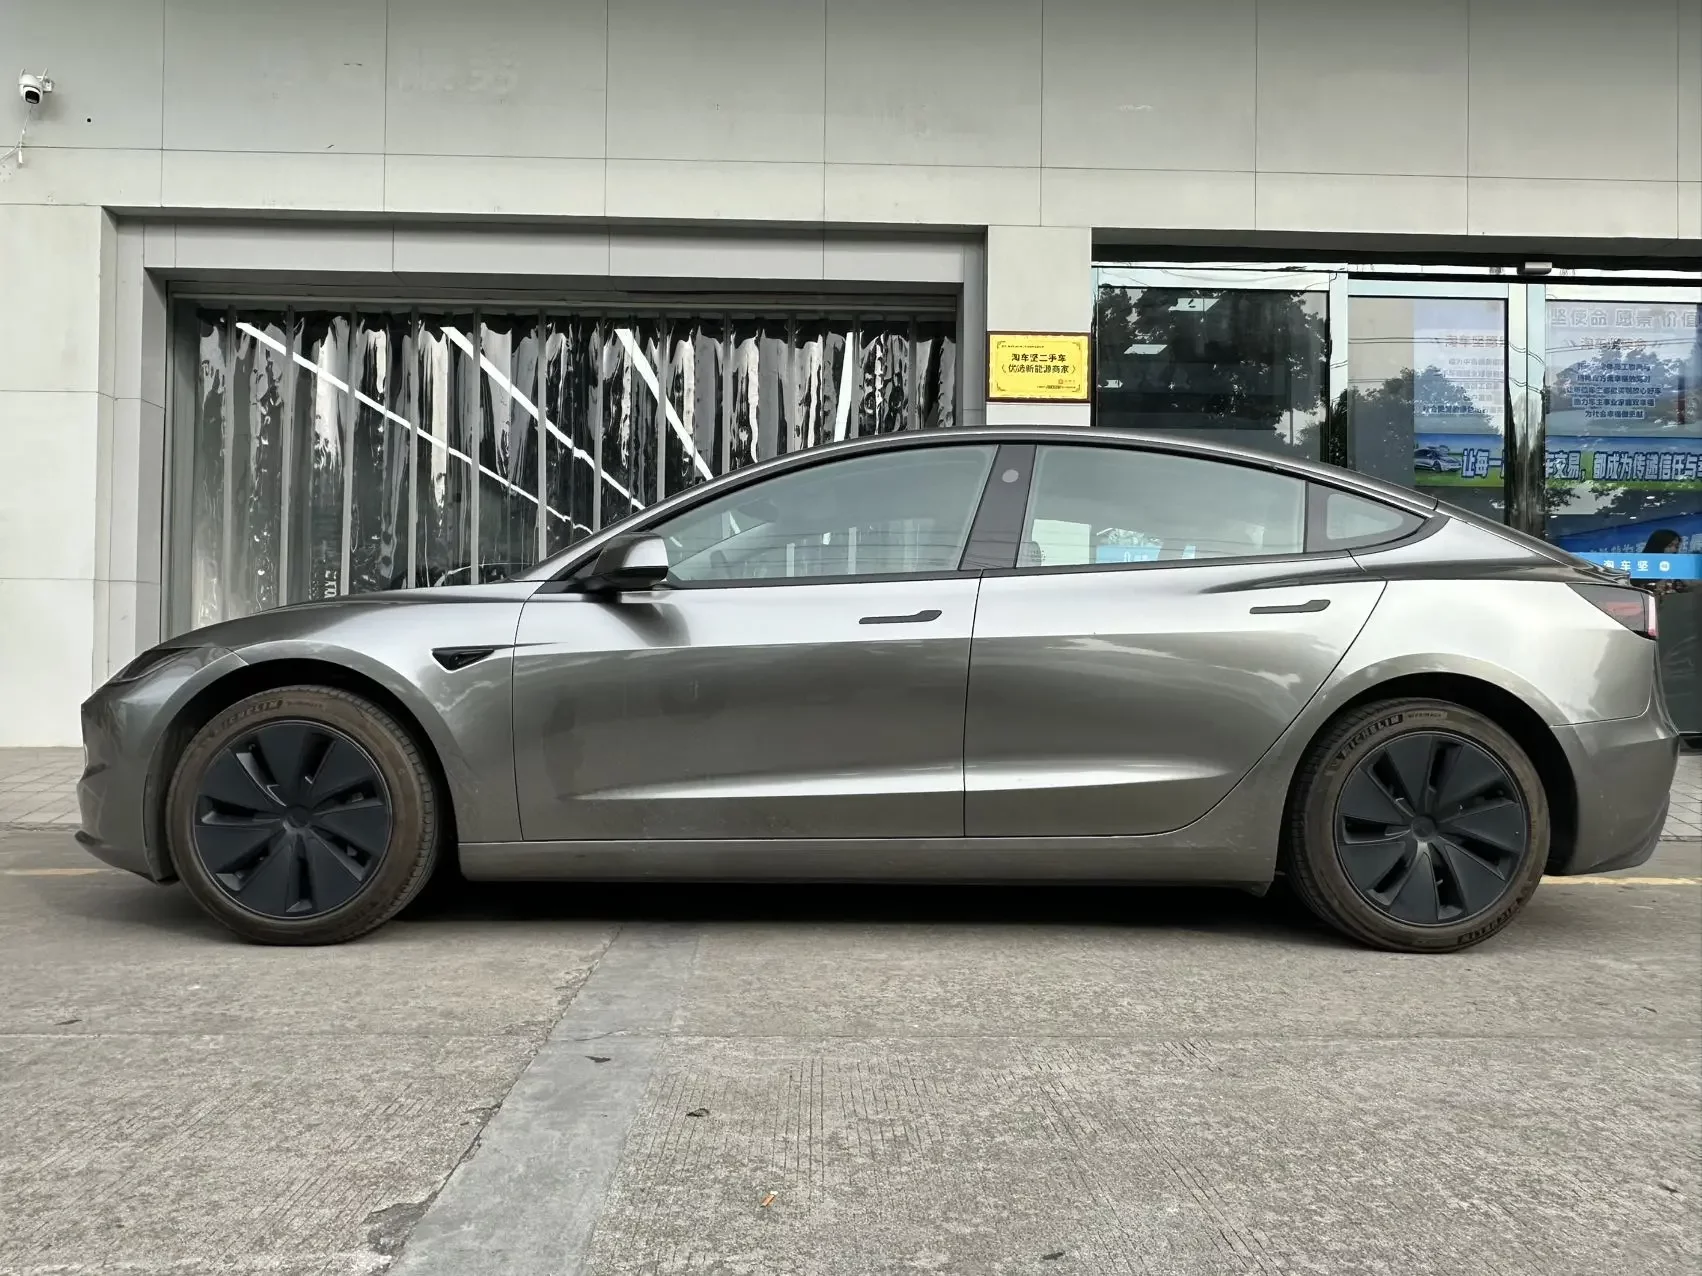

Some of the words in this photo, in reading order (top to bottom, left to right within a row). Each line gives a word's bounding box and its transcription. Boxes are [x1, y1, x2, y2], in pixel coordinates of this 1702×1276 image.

[1011, 353, 1067, 363] 淘车坚二手车
[1461, 449, 1504, 477] 让每一
[1604, 559, 1649, 572] 淘车坚
